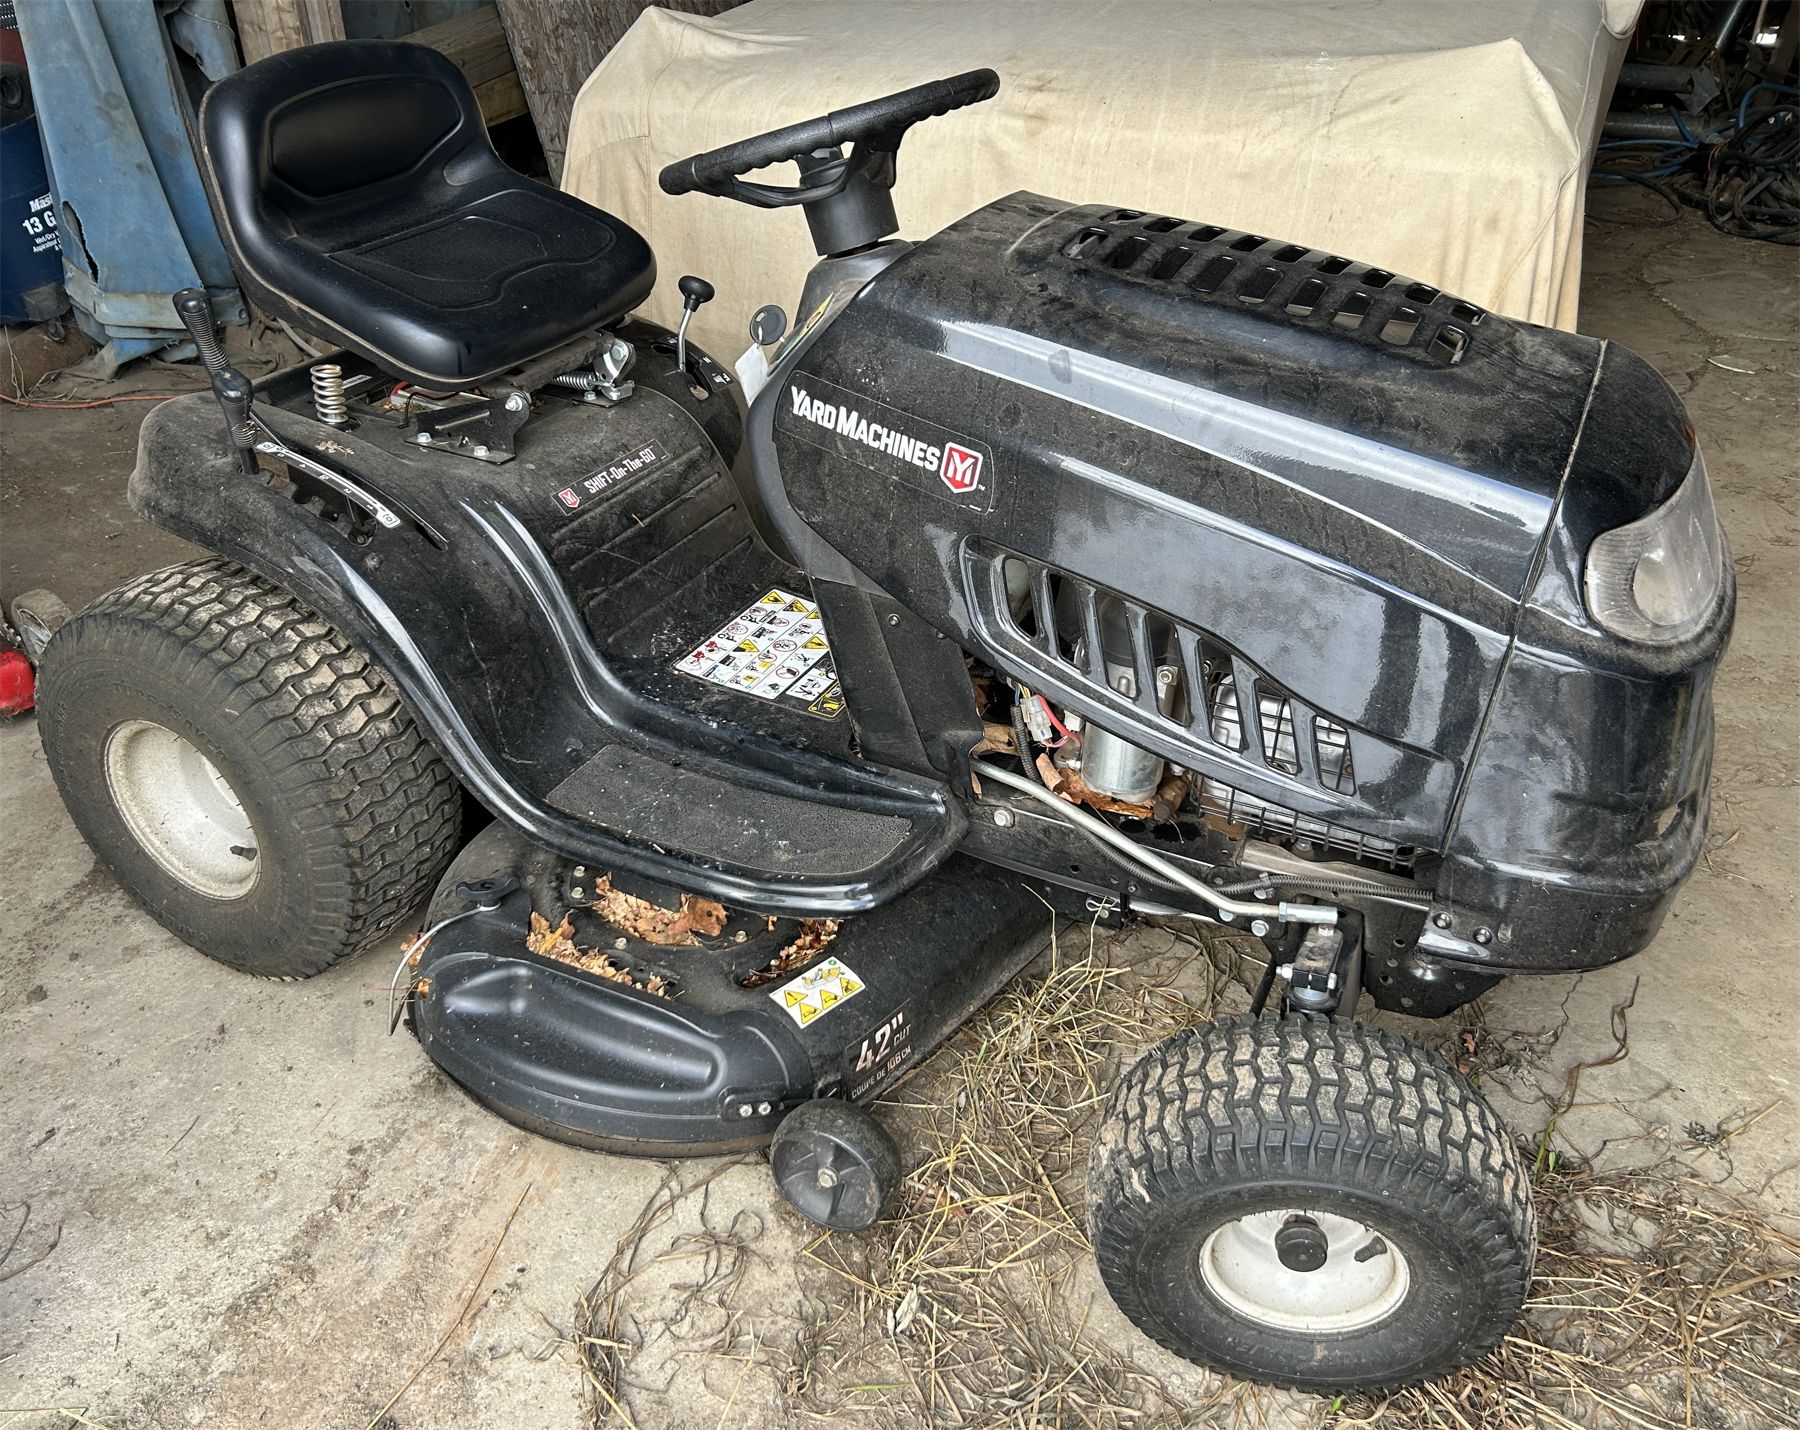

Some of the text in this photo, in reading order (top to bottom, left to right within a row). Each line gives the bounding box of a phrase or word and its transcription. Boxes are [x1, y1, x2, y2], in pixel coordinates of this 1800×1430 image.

[22, 216, 43, 236] 13
[34, 232, 56, 245] Wet/Dry
[855, 1011, 911, 1072] 42" CUT
[851, 1075, 876, 1099] COUPE
[876, 1069, 886, 1081] DE
[901, 1045, 912, 1058] CM
